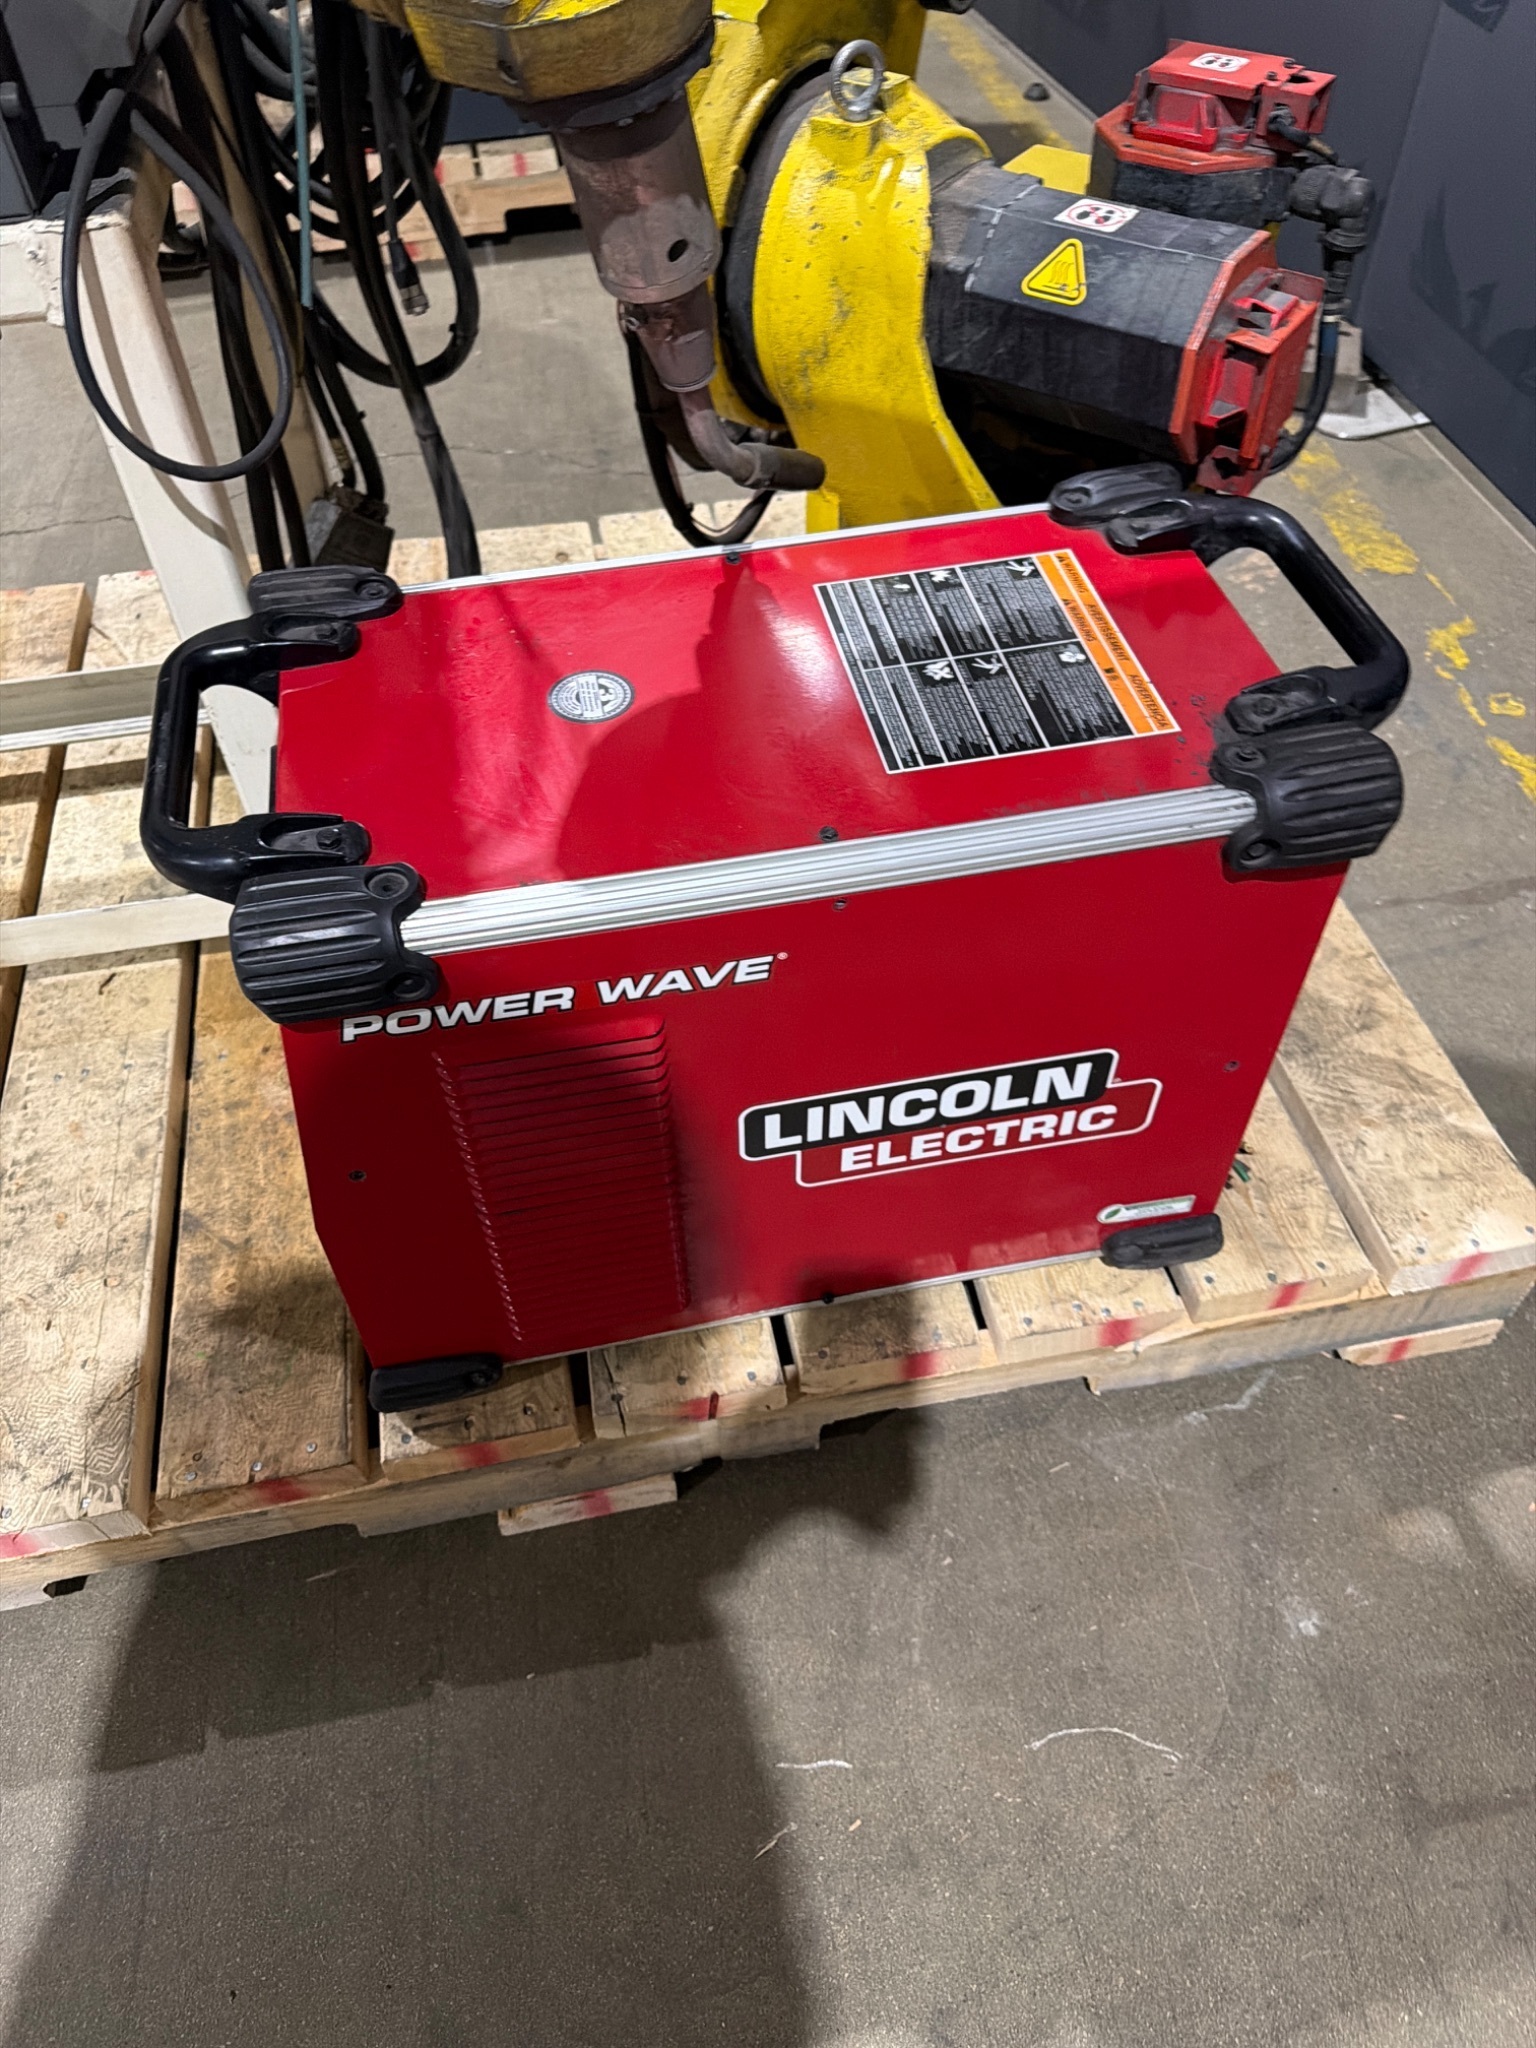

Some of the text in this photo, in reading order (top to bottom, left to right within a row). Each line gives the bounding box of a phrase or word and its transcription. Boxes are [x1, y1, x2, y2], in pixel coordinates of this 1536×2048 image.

[1062, 562, 1089, 594] WARNING
[1087, 603, 1130, 661] AVERTISSEMENT
[341, 986, 575, 1042] POWER
[763, 1061, 1093, 1150] LINCOLN
[839, 1104, 1118, 1173] ELECTRIC
